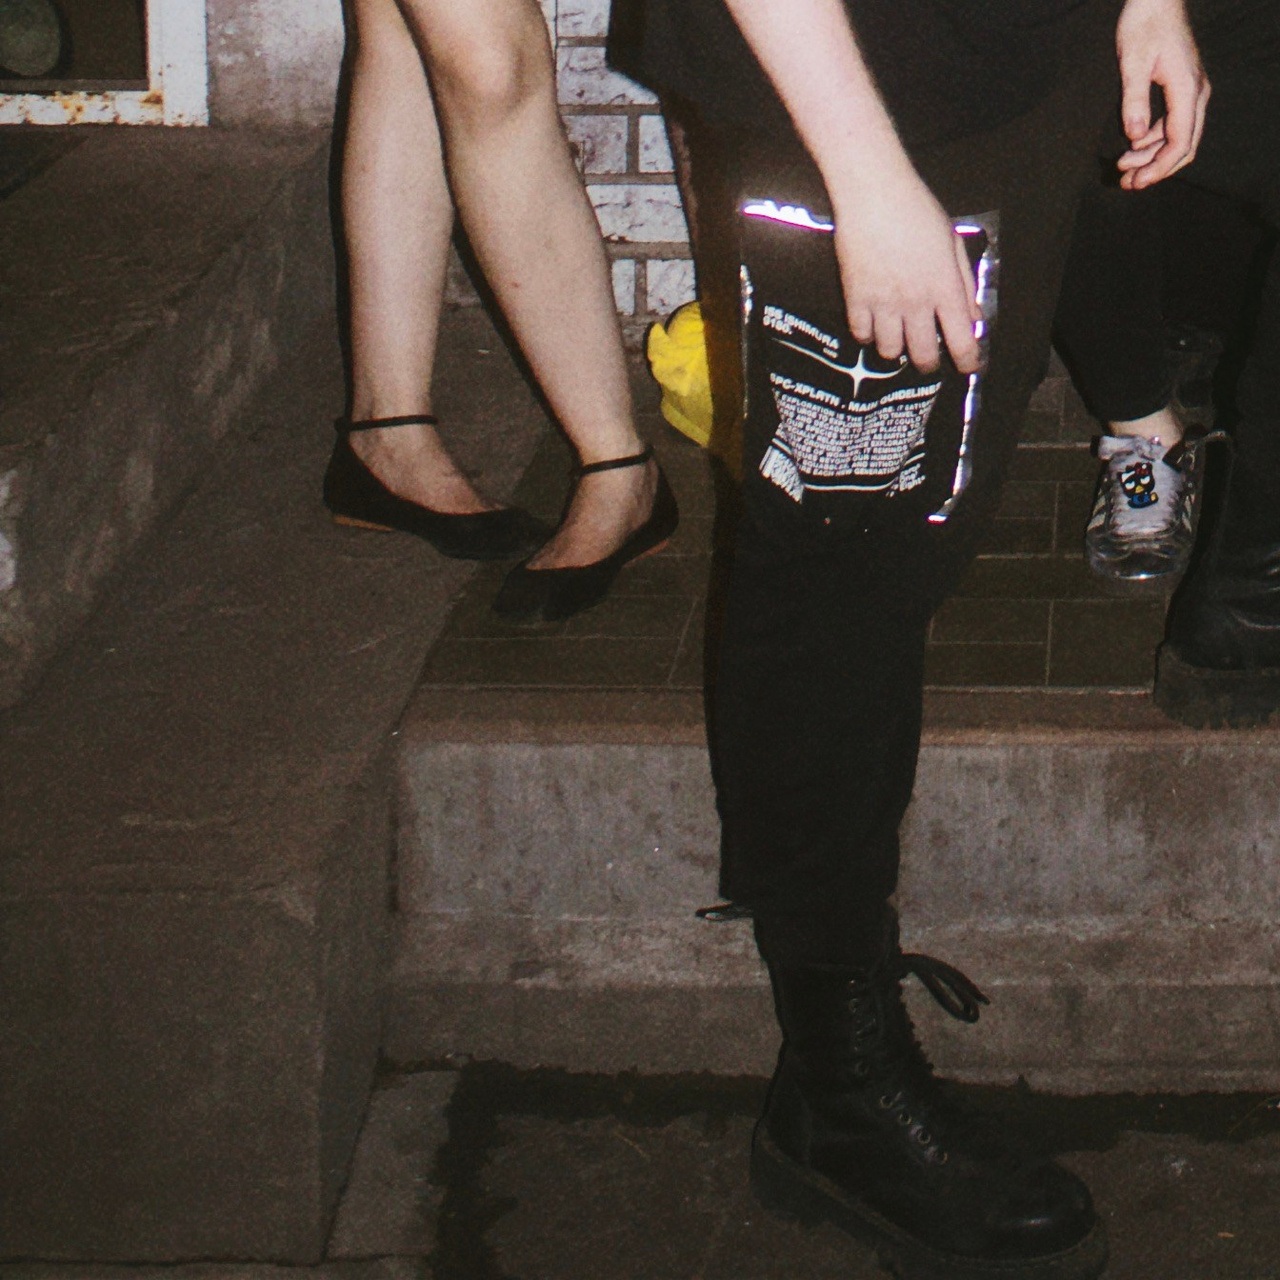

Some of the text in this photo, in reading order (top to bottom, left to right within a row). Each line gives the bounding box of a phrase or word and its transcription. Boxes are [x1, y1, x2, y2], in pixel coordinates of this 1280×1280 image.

[764, 305, 840, 350] ISS ISHIMURA
[781, 394, 835, 417] EXPLORATION
[848, 400, 878, 412] MAIN
[818, 413, 829, 422] TO
[879, 412, 889, 420] TO
[869, 458, 903, 468] WITHOU
